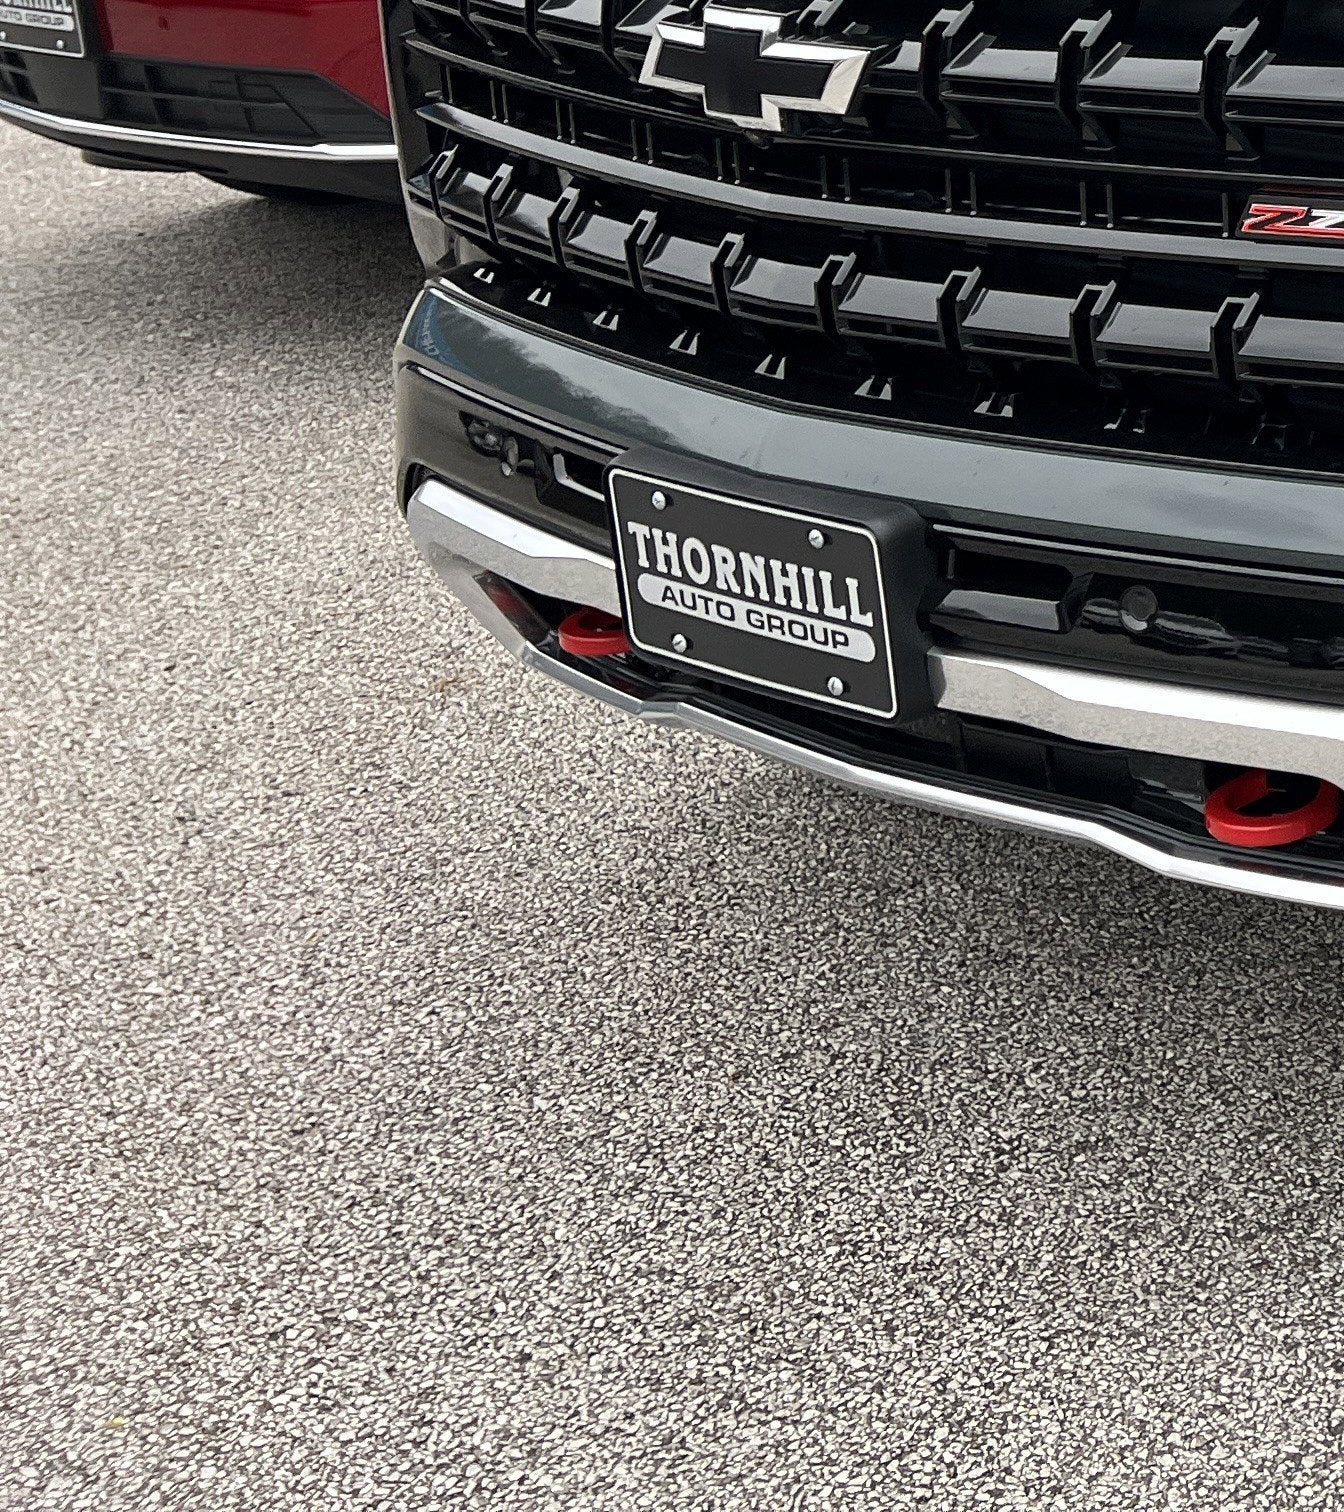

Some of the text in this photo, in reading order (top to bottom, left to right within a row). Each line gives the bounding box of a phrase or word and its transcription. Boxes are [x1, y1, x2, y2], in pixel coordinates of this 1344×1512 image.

[626, 520, 874, 628] THORNHILL
[661, 585, 849, 649] AUTO GROUP
